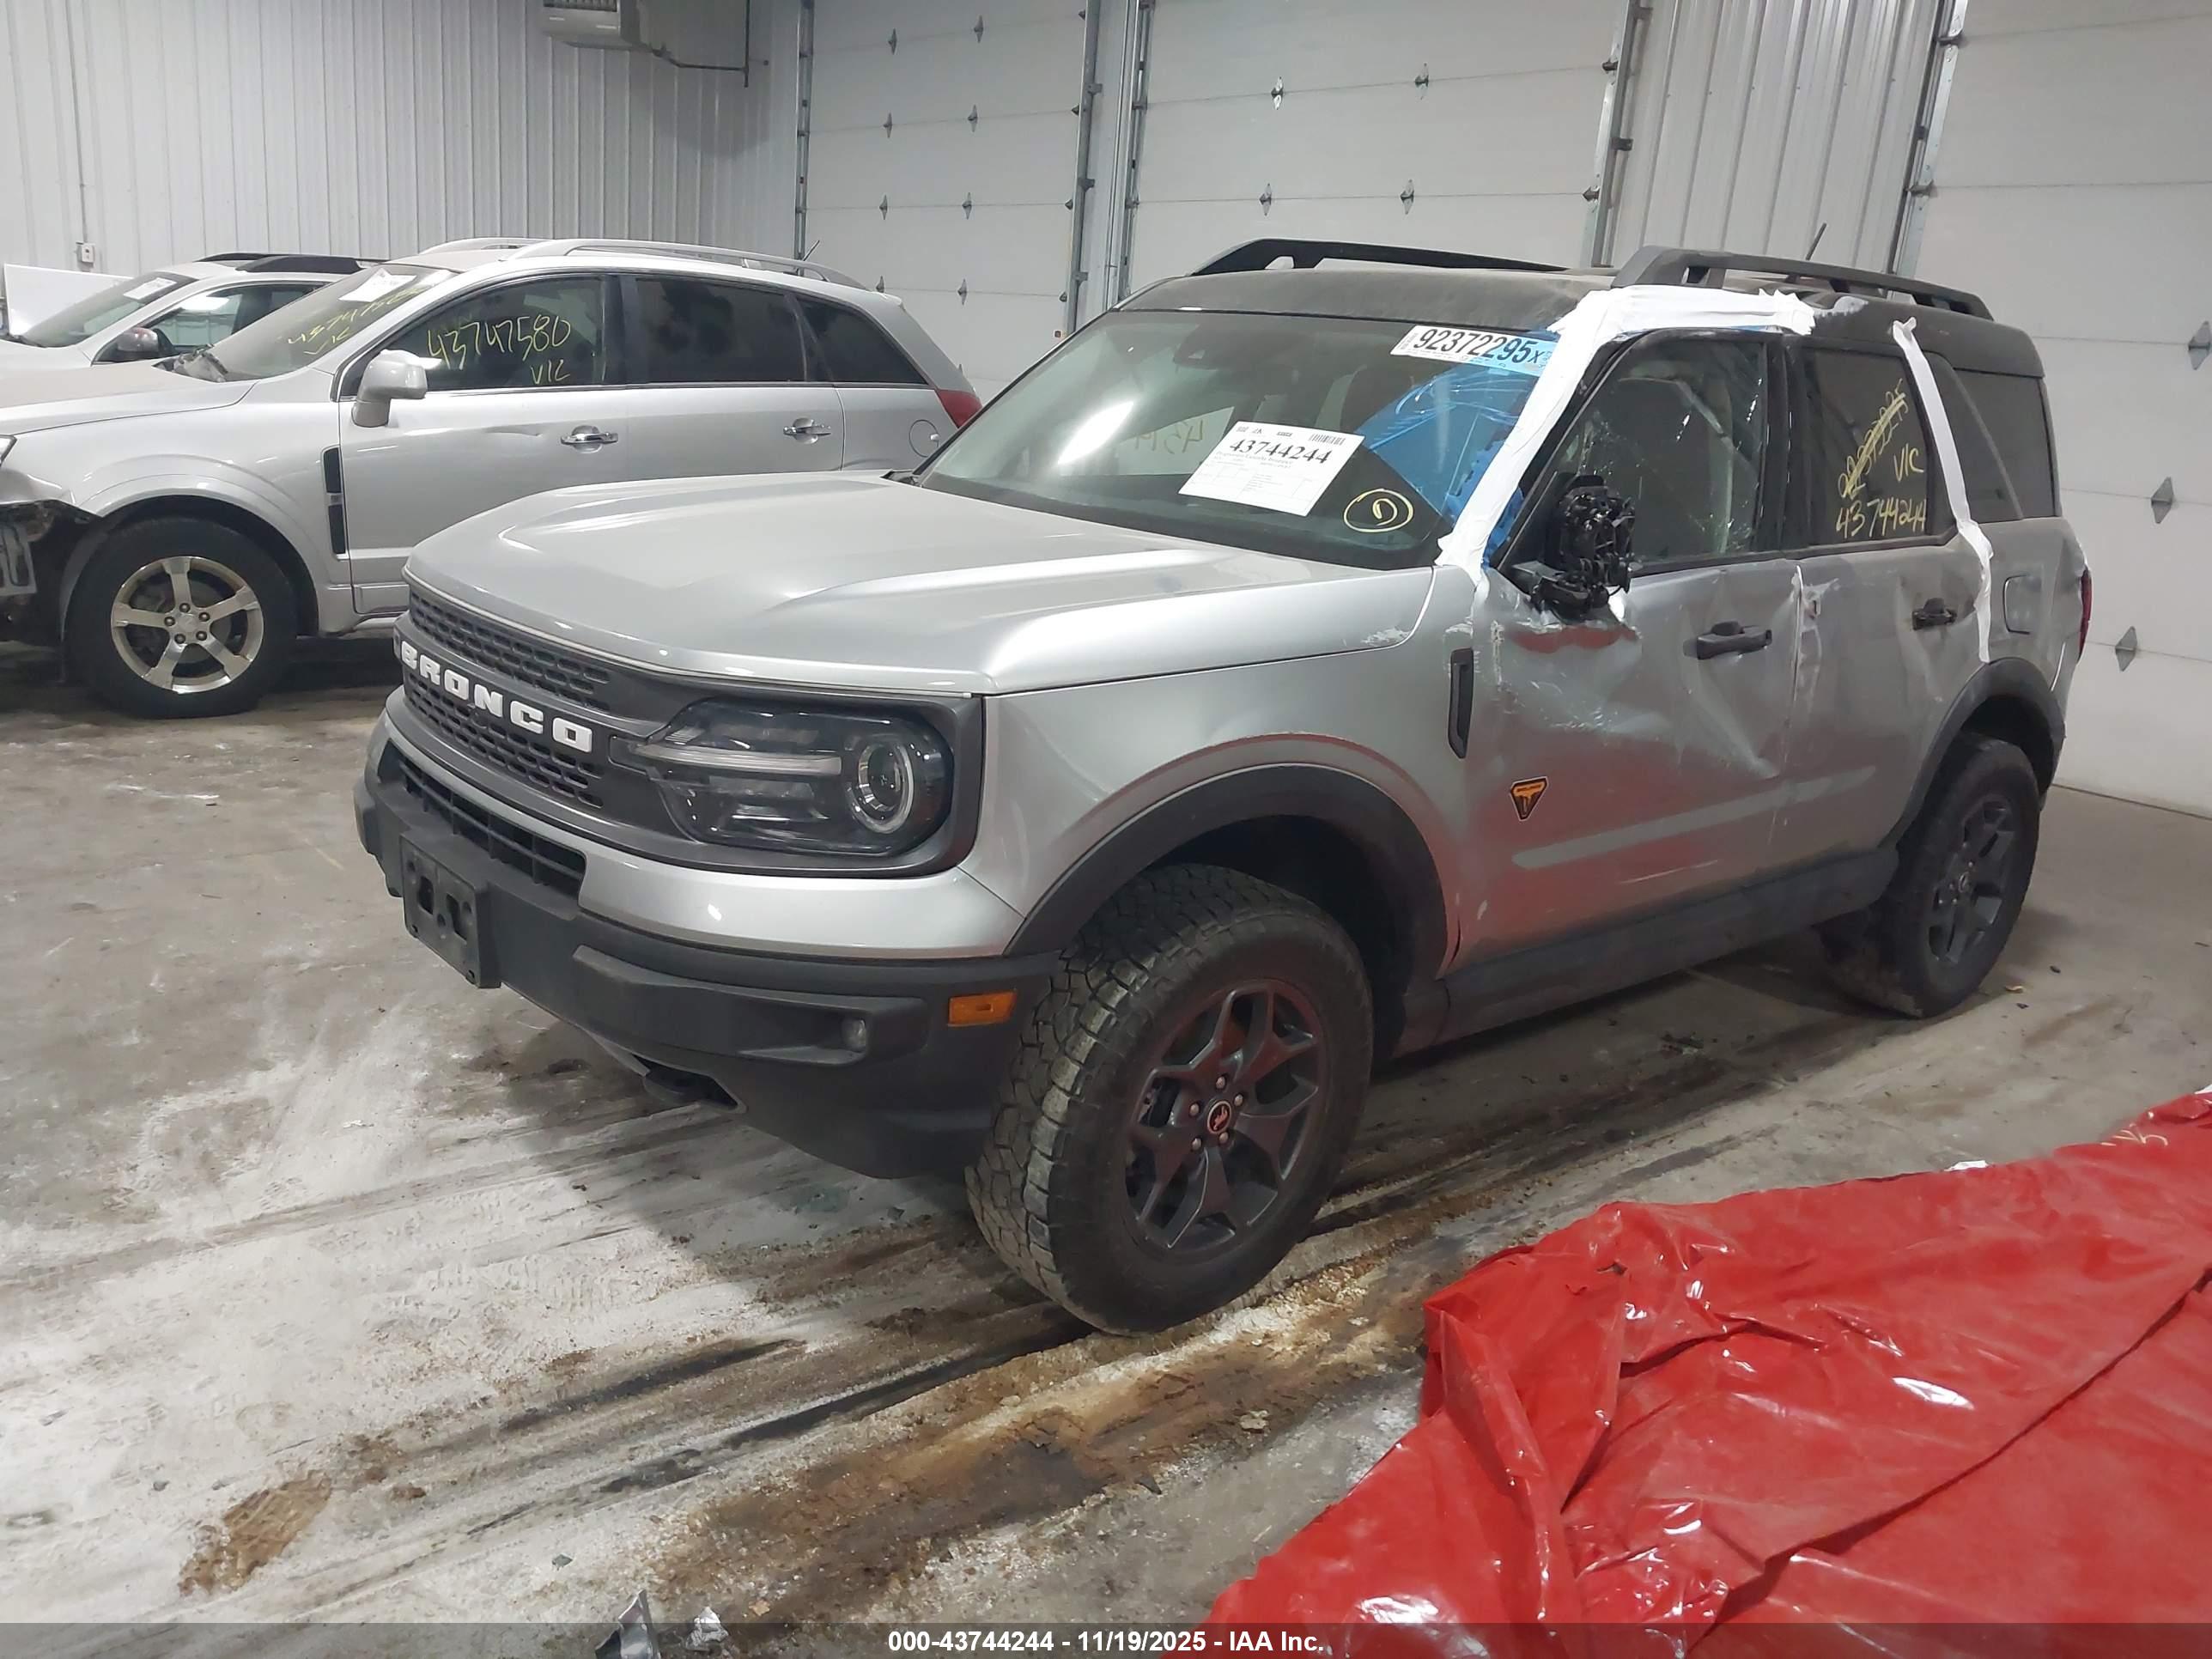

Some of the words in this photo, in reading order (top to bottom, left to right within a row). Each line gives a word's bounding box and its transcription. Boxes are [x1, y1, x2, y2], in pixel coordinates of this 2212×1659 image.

[428, 313, 571, 370] 43747580
[1229, 439, 1332, 464] 43744244
[1893, 442, 1924, 483] VIC
[1836, 496, 1927, 538] 43744244
[401, 641, 592, 753] BRONCO
